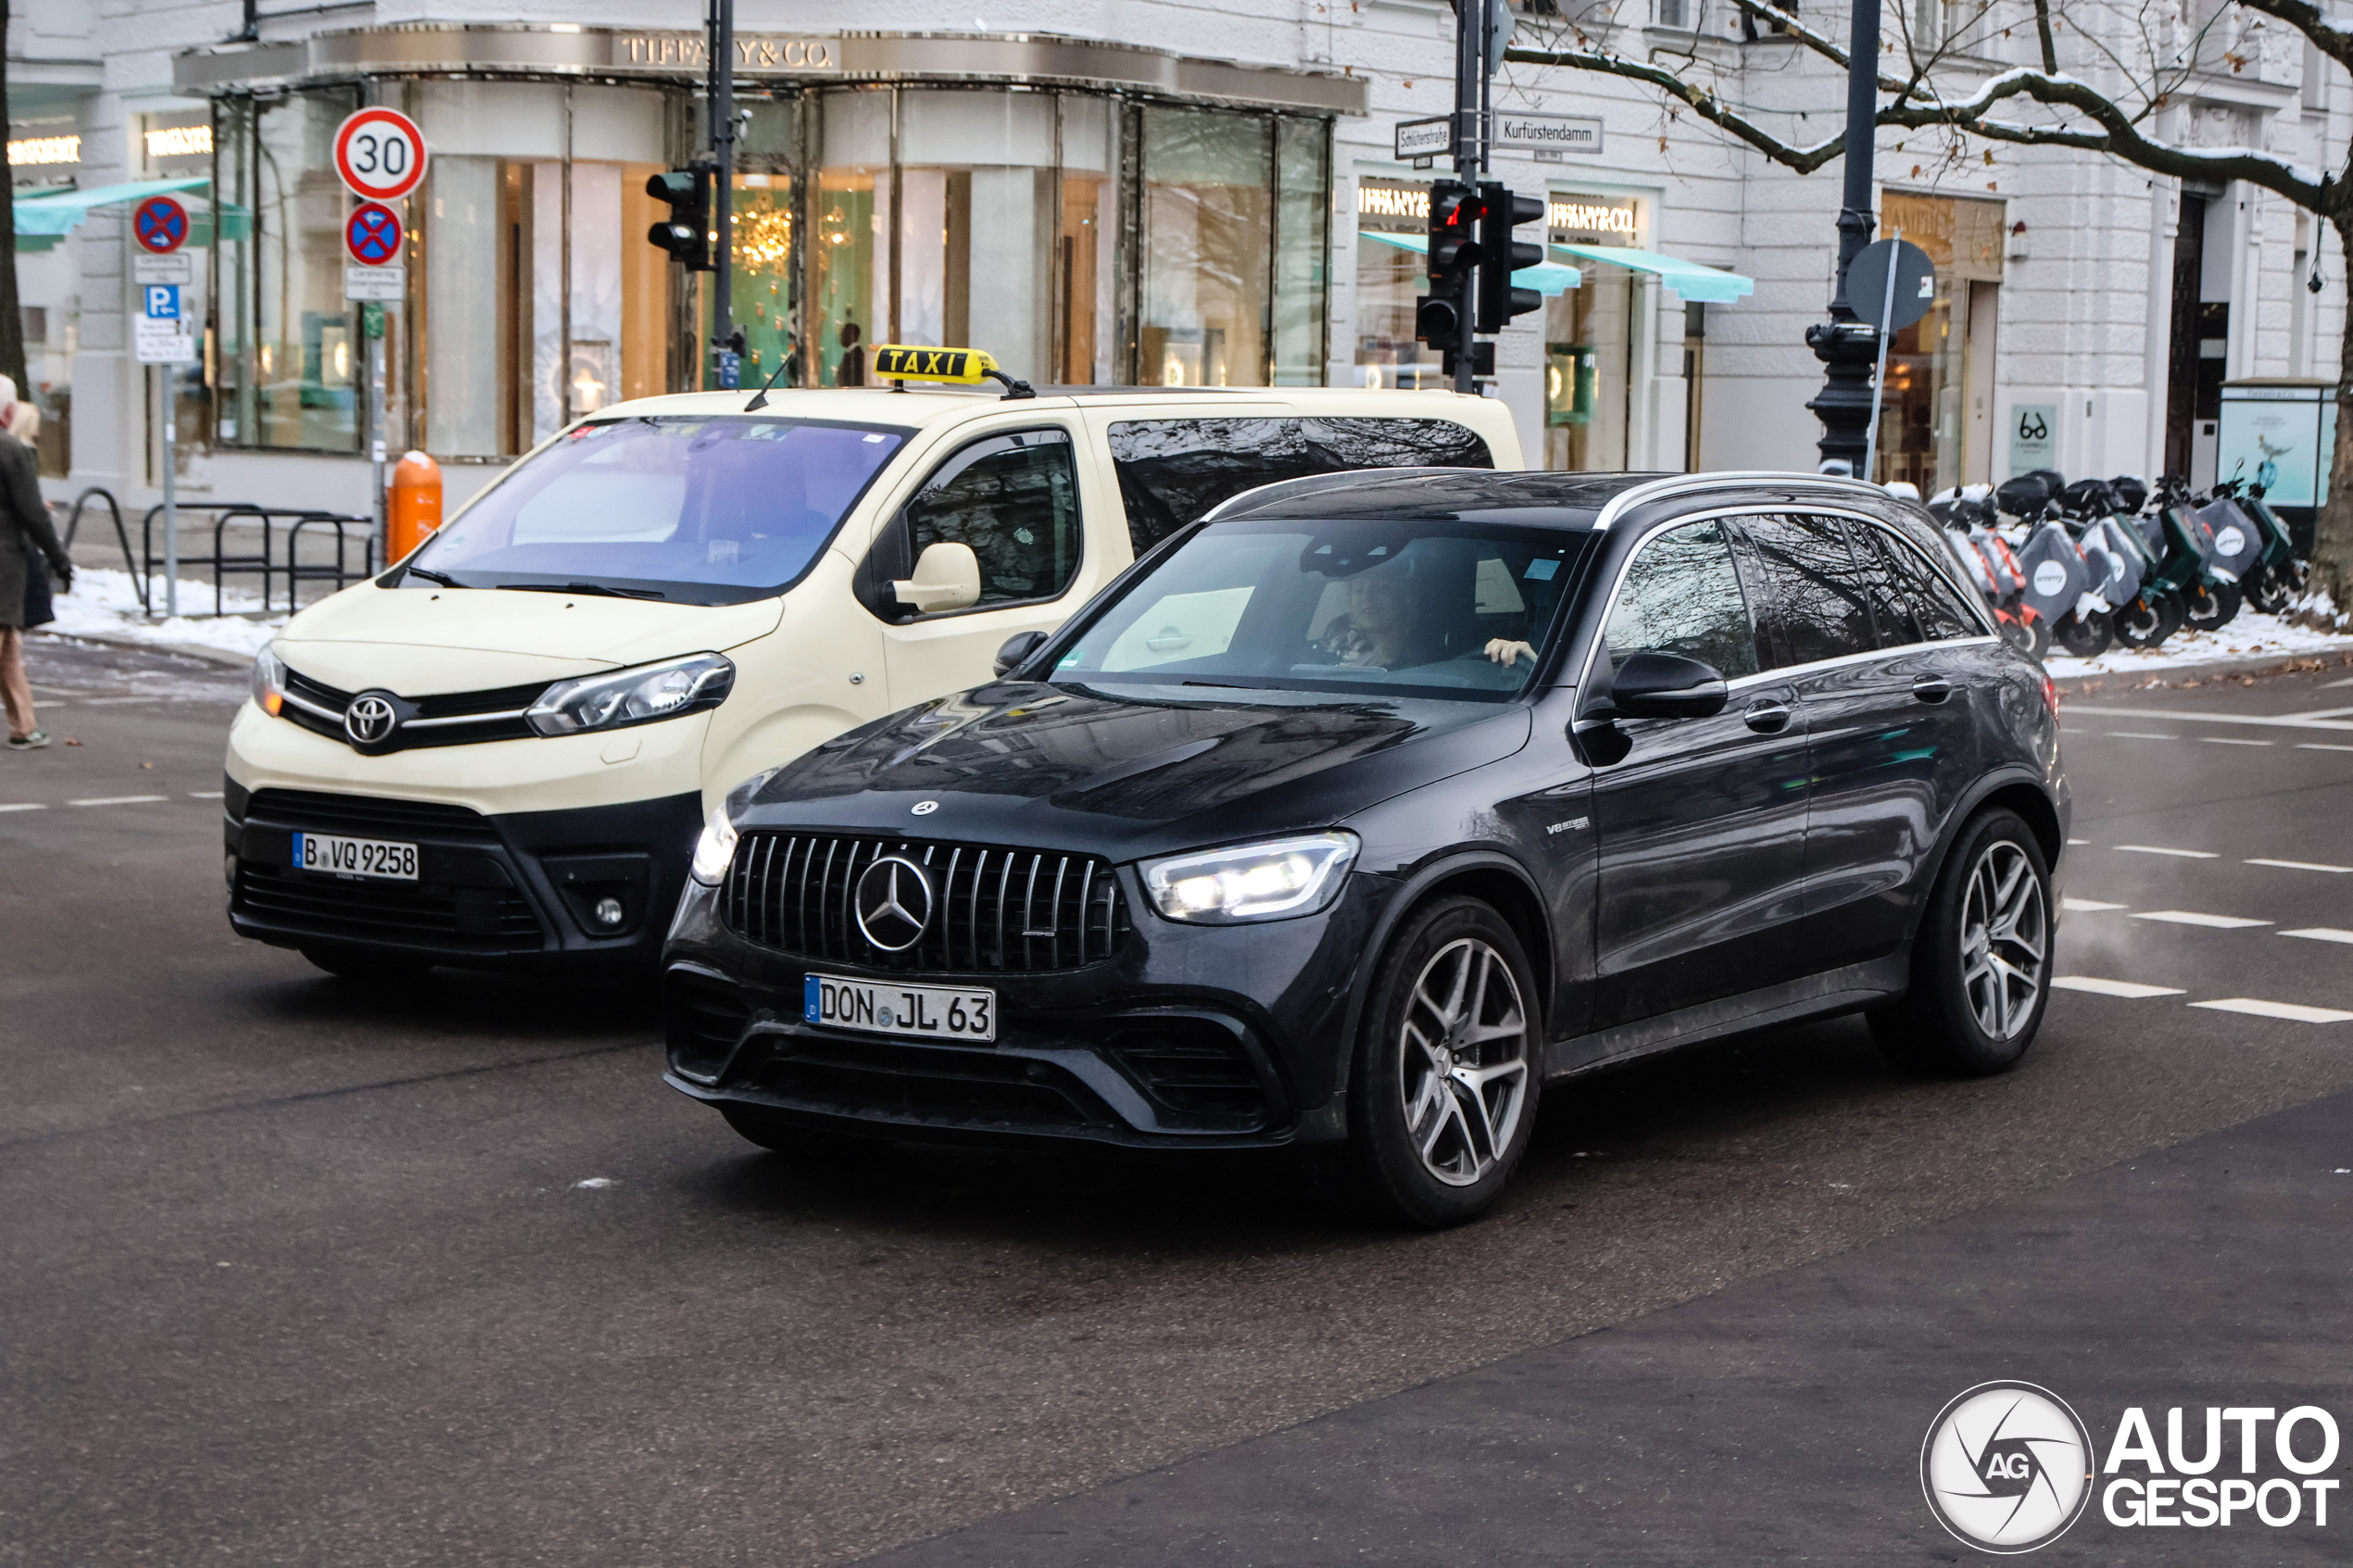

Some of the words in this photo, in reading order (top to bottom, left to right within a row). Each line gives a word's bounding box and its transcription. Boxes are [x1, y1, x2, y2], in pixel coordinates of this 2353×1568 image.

[622, 38, 833, 68] TIFFAY&CO.
[1504, 121, 1592, 142] Kurfürstendamm
[356, 134, 406, 175] 30
[150, 287, 171, 316] P
[889, 350, 955, 374] TAXI
[1545, 823, 1563, 834] V8
[305, 838, 317, 865] B
[332, 840, 357, 870] VQ
[362, 844, 415, 875] 9258
[809, 1005, 816, 1014] D
[821, 984, 874, 1025] DON
[897, 993, 937, 1031] JL
[948, 997, 988, 1034] 63
